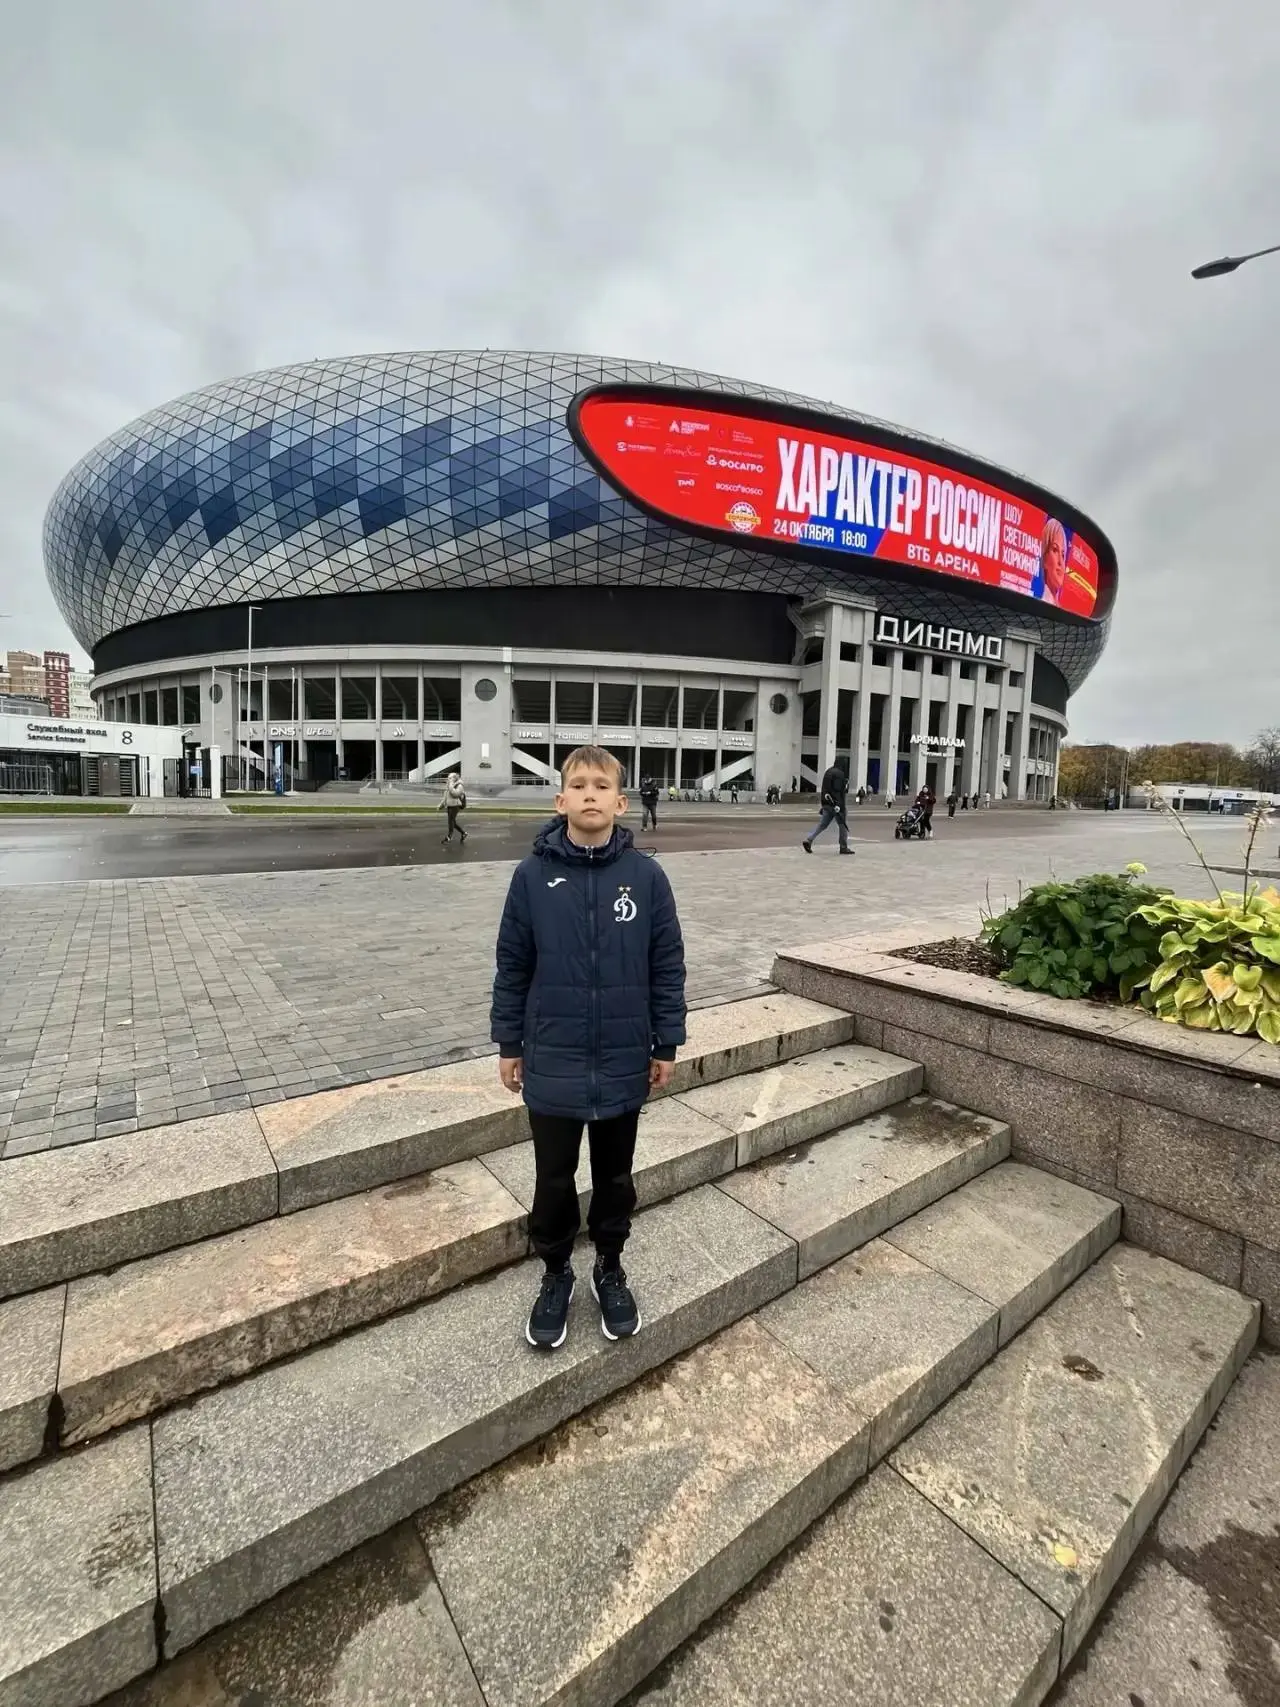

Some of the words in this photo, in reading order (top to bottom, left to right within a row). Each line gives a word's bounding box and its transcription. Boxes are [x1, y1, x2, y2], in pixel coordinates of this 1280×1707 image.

[719, 459, 764, 473] ФОСАГРО
[775, 437, 922, 536] ХАРАКТЕР
[925, 474, 1002, 561] РОССИИ
[1004, 502, 1023, 526] ШОУ
[773, 519, 787, 535] 24
[789, 522, 834, 543] ОКТЯБРЯ
[841, 530, 867, 549] 18:00
[1003, 524, 1042, 557] СВЕТЛАНЫ
[907, 543, 930, 563] ВТБ
[934, 551, 980, 577] АРЕНА
[1001, 545, 1040, 578] ХОРКИНОЙ
[877, 616, 1002, 659] ДИНАМО
[27, 723, 83, 735] Служебный
[86, 728, 107, 737] вход
[56, 735, 85, 743] Entrance
[122, 731, 133, 745] 8
[270, 727, 296, 736] DNS
[910, 734, 939, 745] АРЕНА
[940, 736, 966, 748] ПЛАЗА
